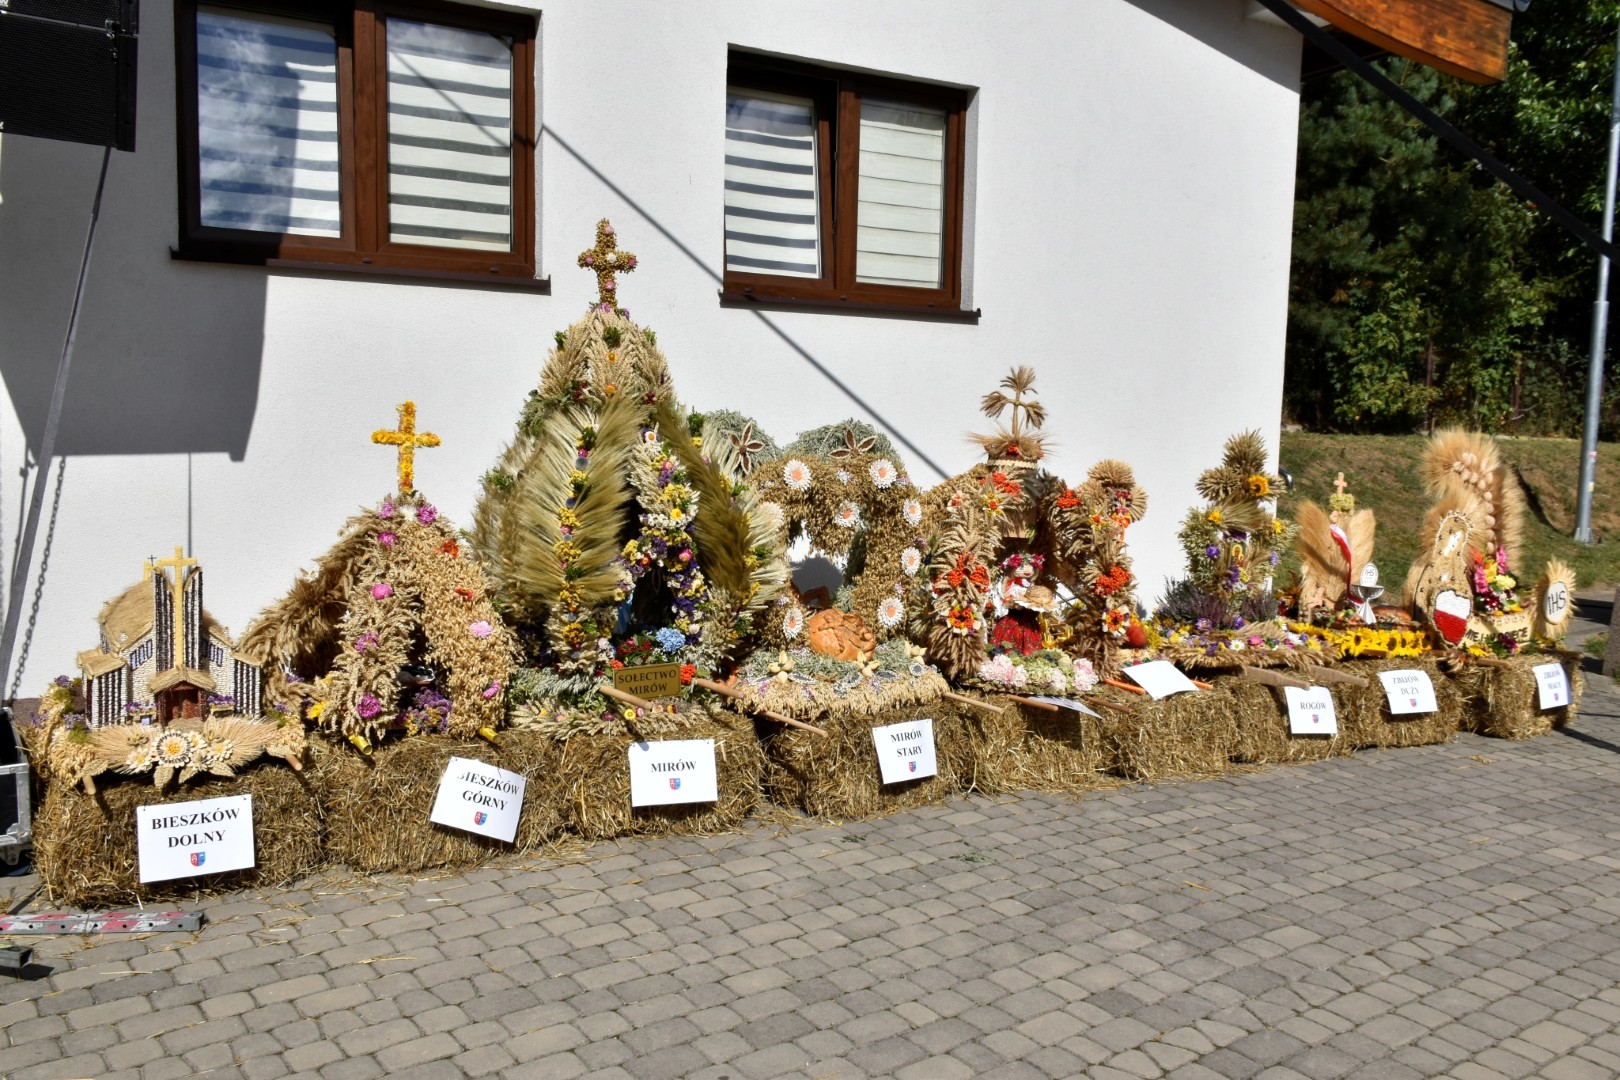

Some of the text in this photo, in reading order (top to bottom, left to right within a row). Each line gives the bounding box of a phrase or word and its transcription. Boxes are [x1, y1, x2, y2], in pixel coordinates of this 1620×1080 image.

[1547, 590, 1566, 615] IHS
[618, 669, 677, 684] SOŁECTWO
[629, 683, 668, 695] MIRÓW
[1300, 700, 1327, 710] ROGÓW
[890, 728, 923, 743] MIRÓW
[896, 745, 923, 758] STARY
[650, 758, 697, 773] MIRÓW
[462, 789, 508, 811] GÓRNY
[151, 807, 241, 830] BIESZKÓW
[167, 829, 227, 849] DOLNY
